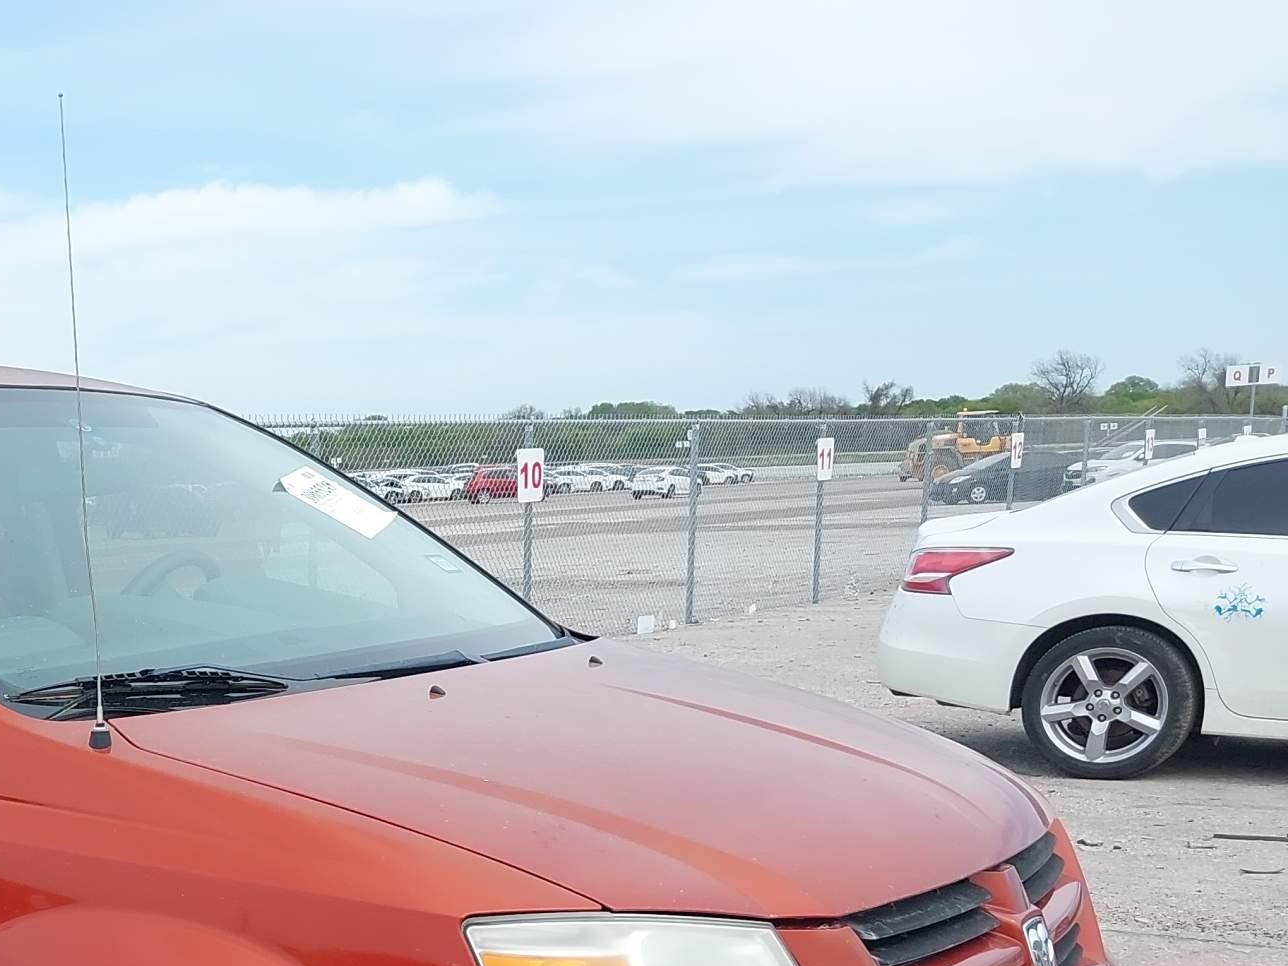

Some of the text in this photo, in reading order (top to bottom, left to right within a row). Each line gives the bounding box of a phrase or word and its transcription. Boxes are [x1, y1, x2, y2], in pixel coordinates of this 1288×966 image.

[1267, 367, 1275, 379] P
[819, 448, 832, 470] 11
[1013, 441, 1023, 459] 12
[520, 462, 542, 489] 10
